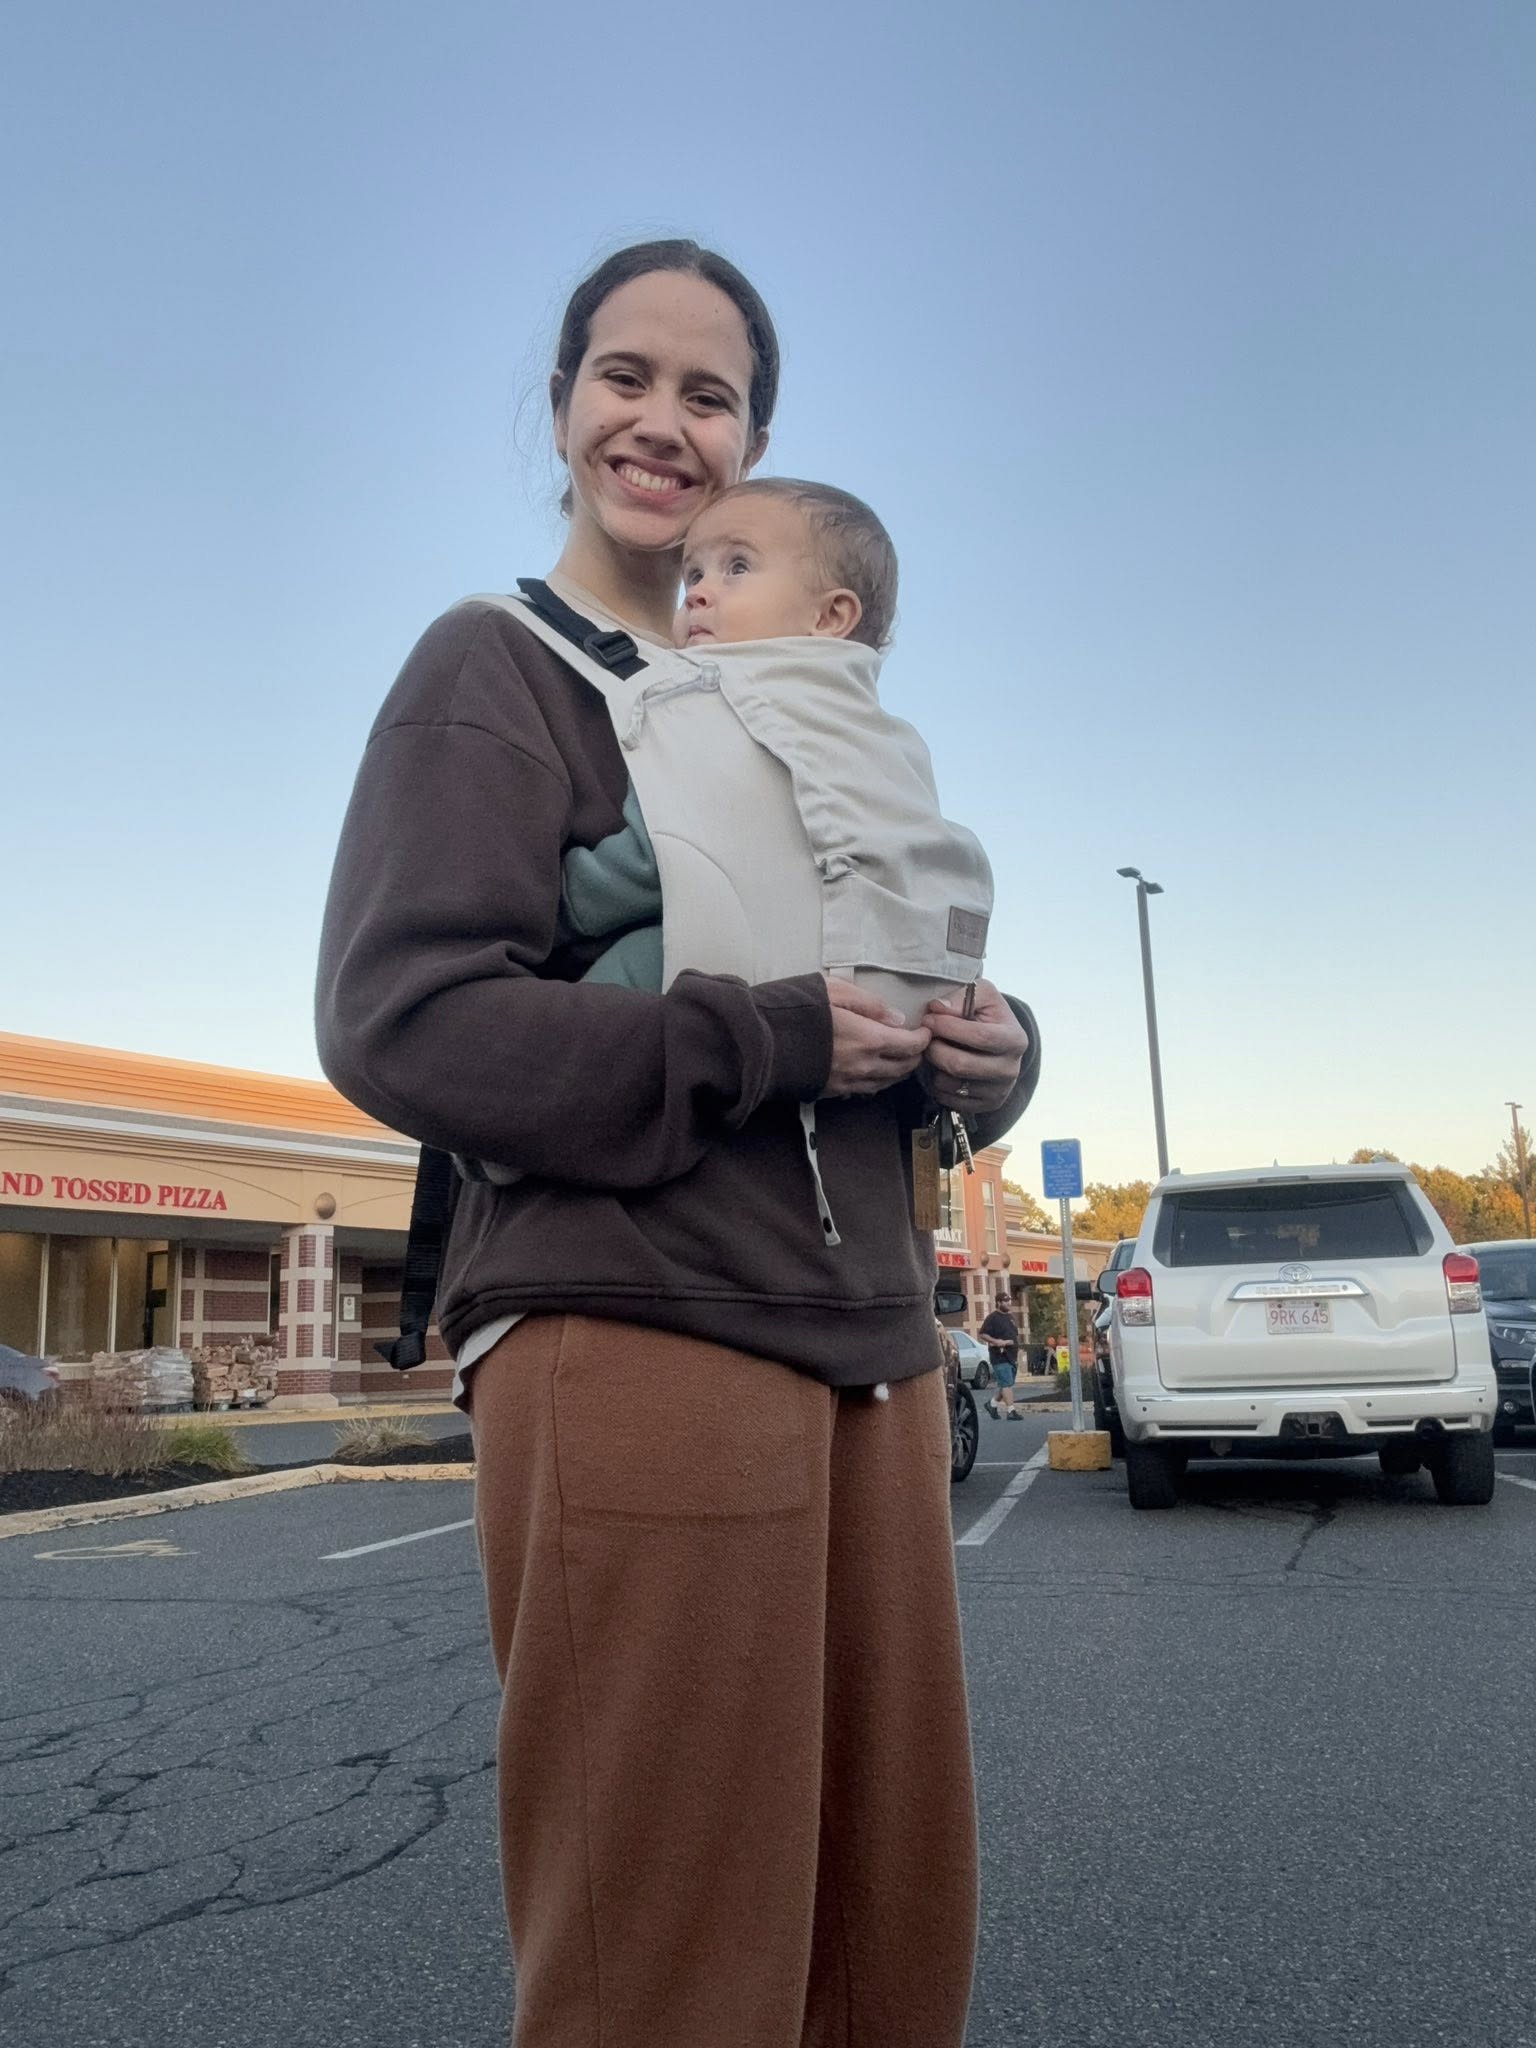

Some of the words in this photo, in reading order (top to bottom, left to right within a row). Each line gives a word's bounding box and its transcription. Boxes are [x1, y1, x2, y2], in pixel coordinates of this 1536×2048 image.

[0, 1171, 44, 1197] ND
[51, 1175, 152, 1204] TOSSED
[157, 1184, 228, 1211] PIZZA
[1270, 1309, 1297, 1326] 9RK
[1302, 1308, 1329, 1325] 645
